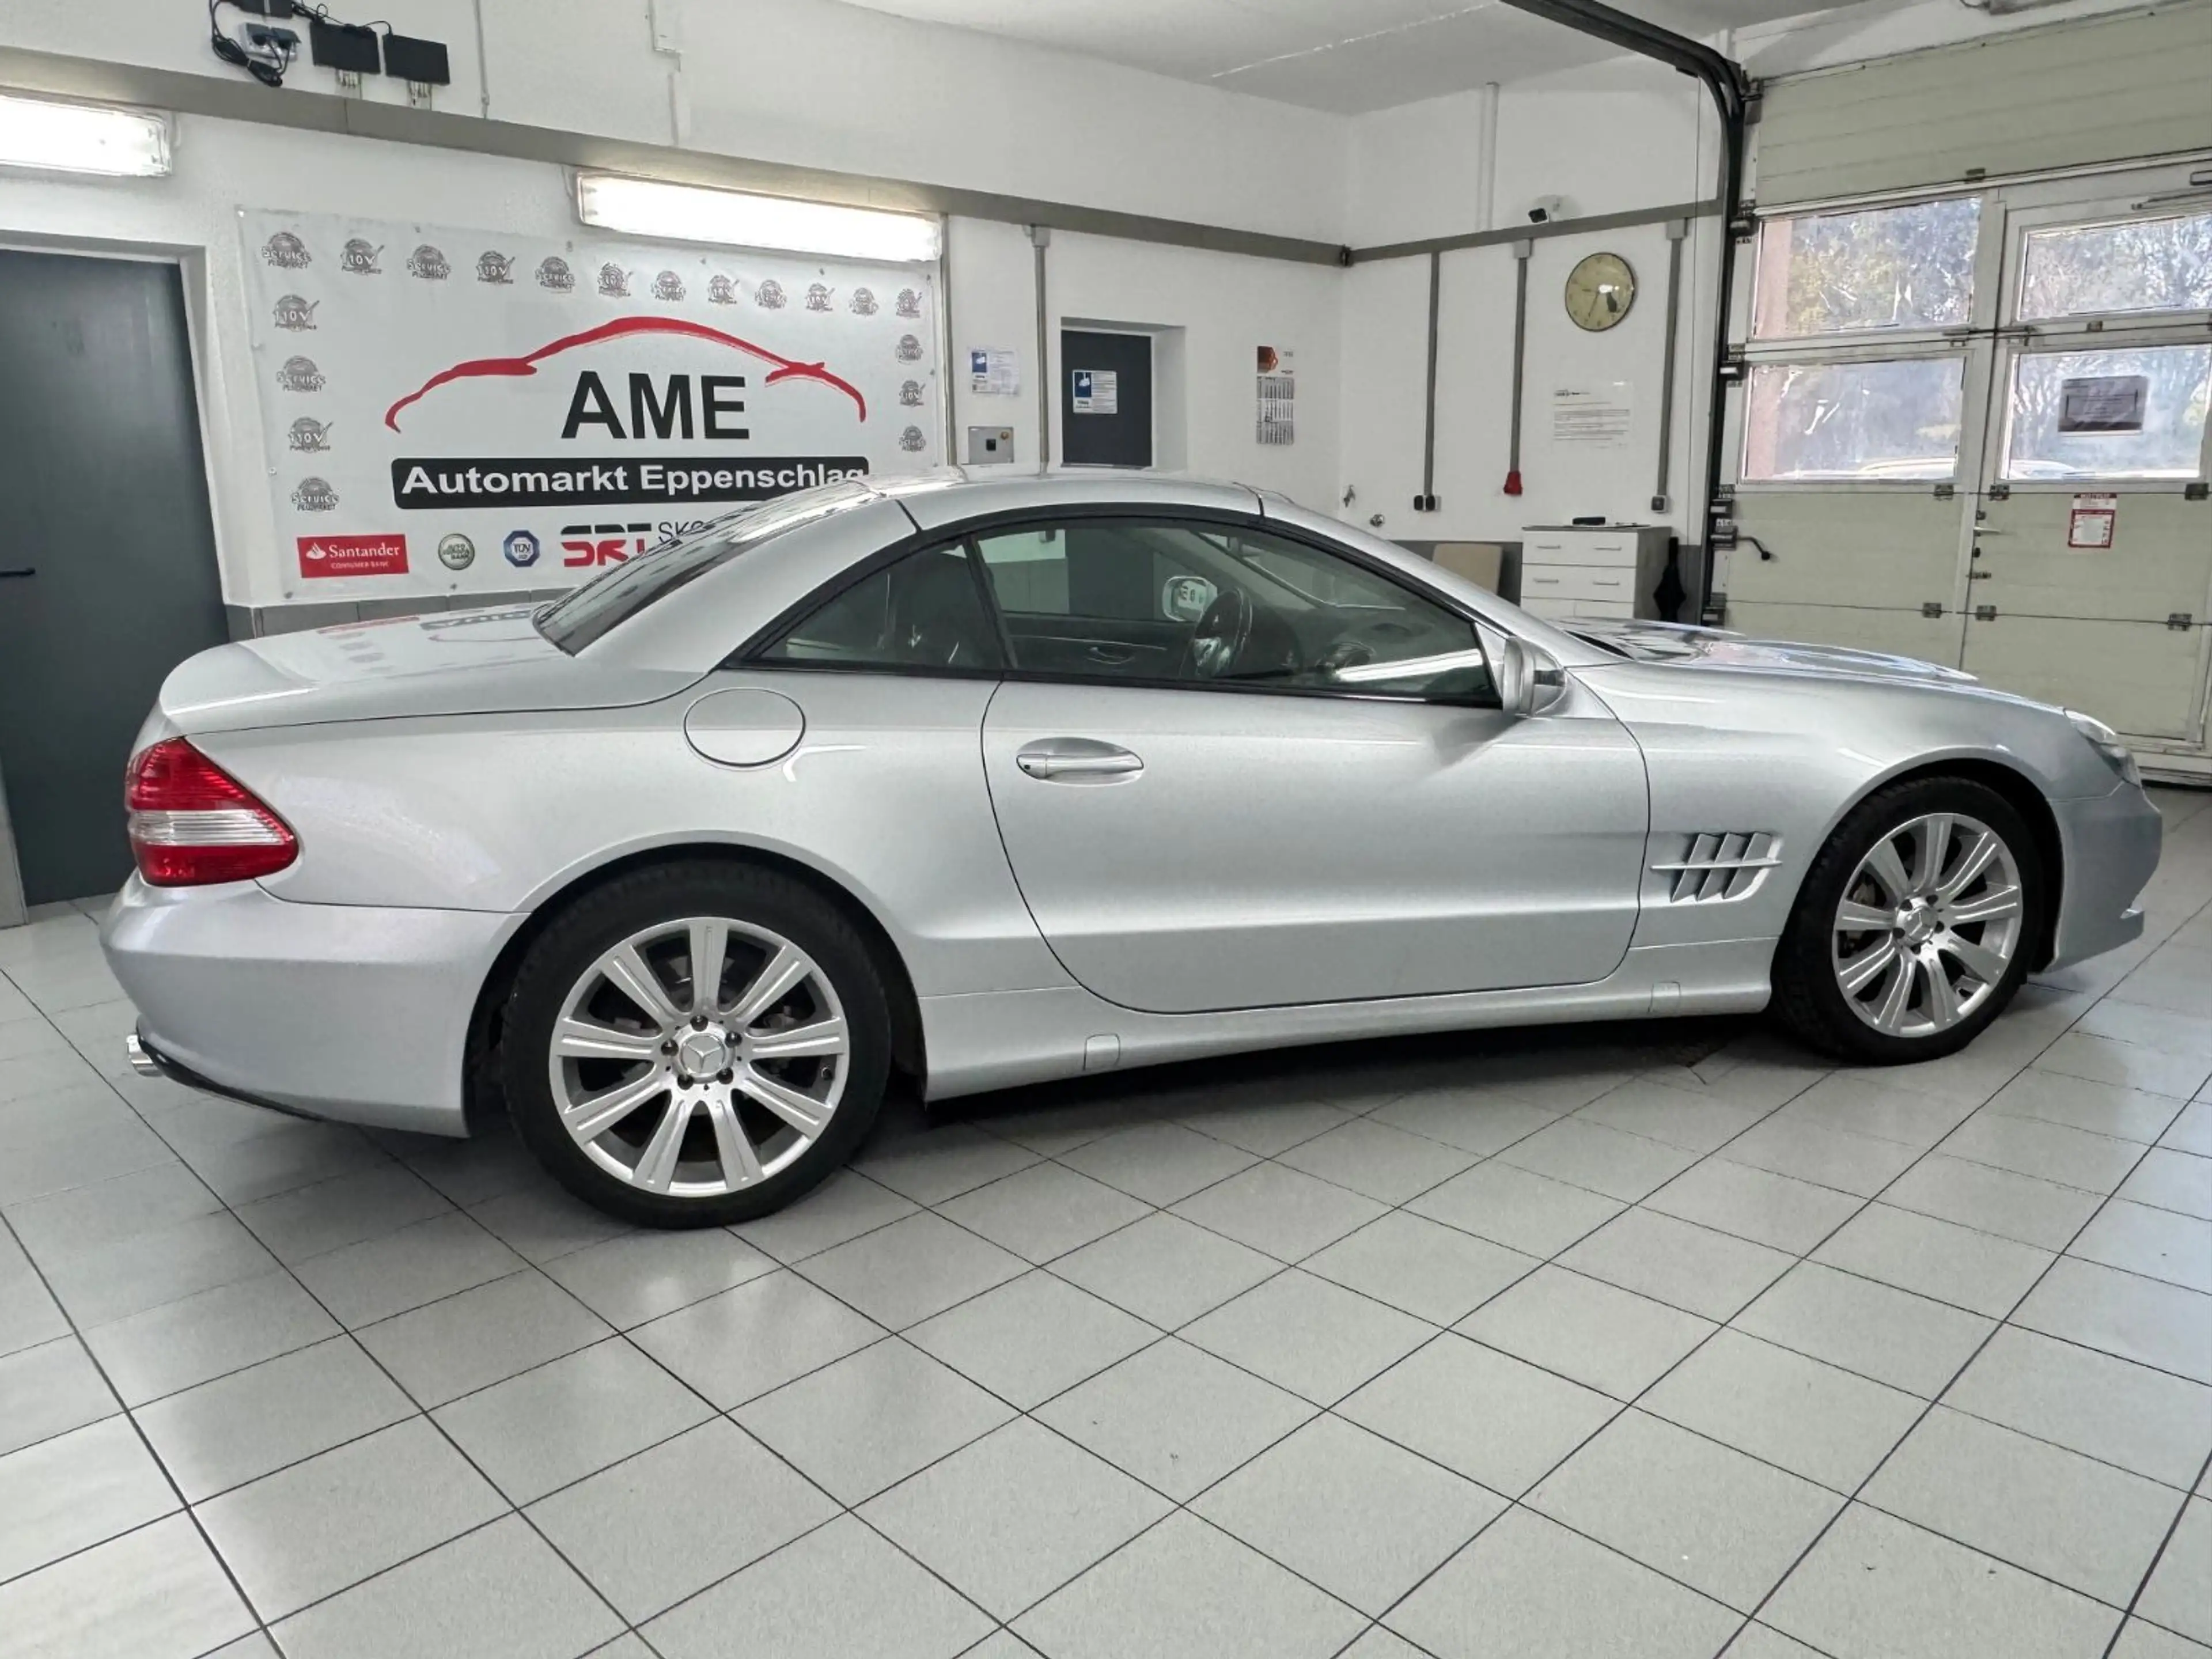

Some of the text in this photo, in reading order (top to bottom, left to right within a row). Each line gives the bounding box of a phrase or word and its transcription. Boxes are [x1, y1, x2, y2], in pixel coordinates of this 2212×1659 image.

[561, 370, 749, 440] AME
[402, 465, 629, 494] Automarkt
[329, 542, 400, 558] Santander
